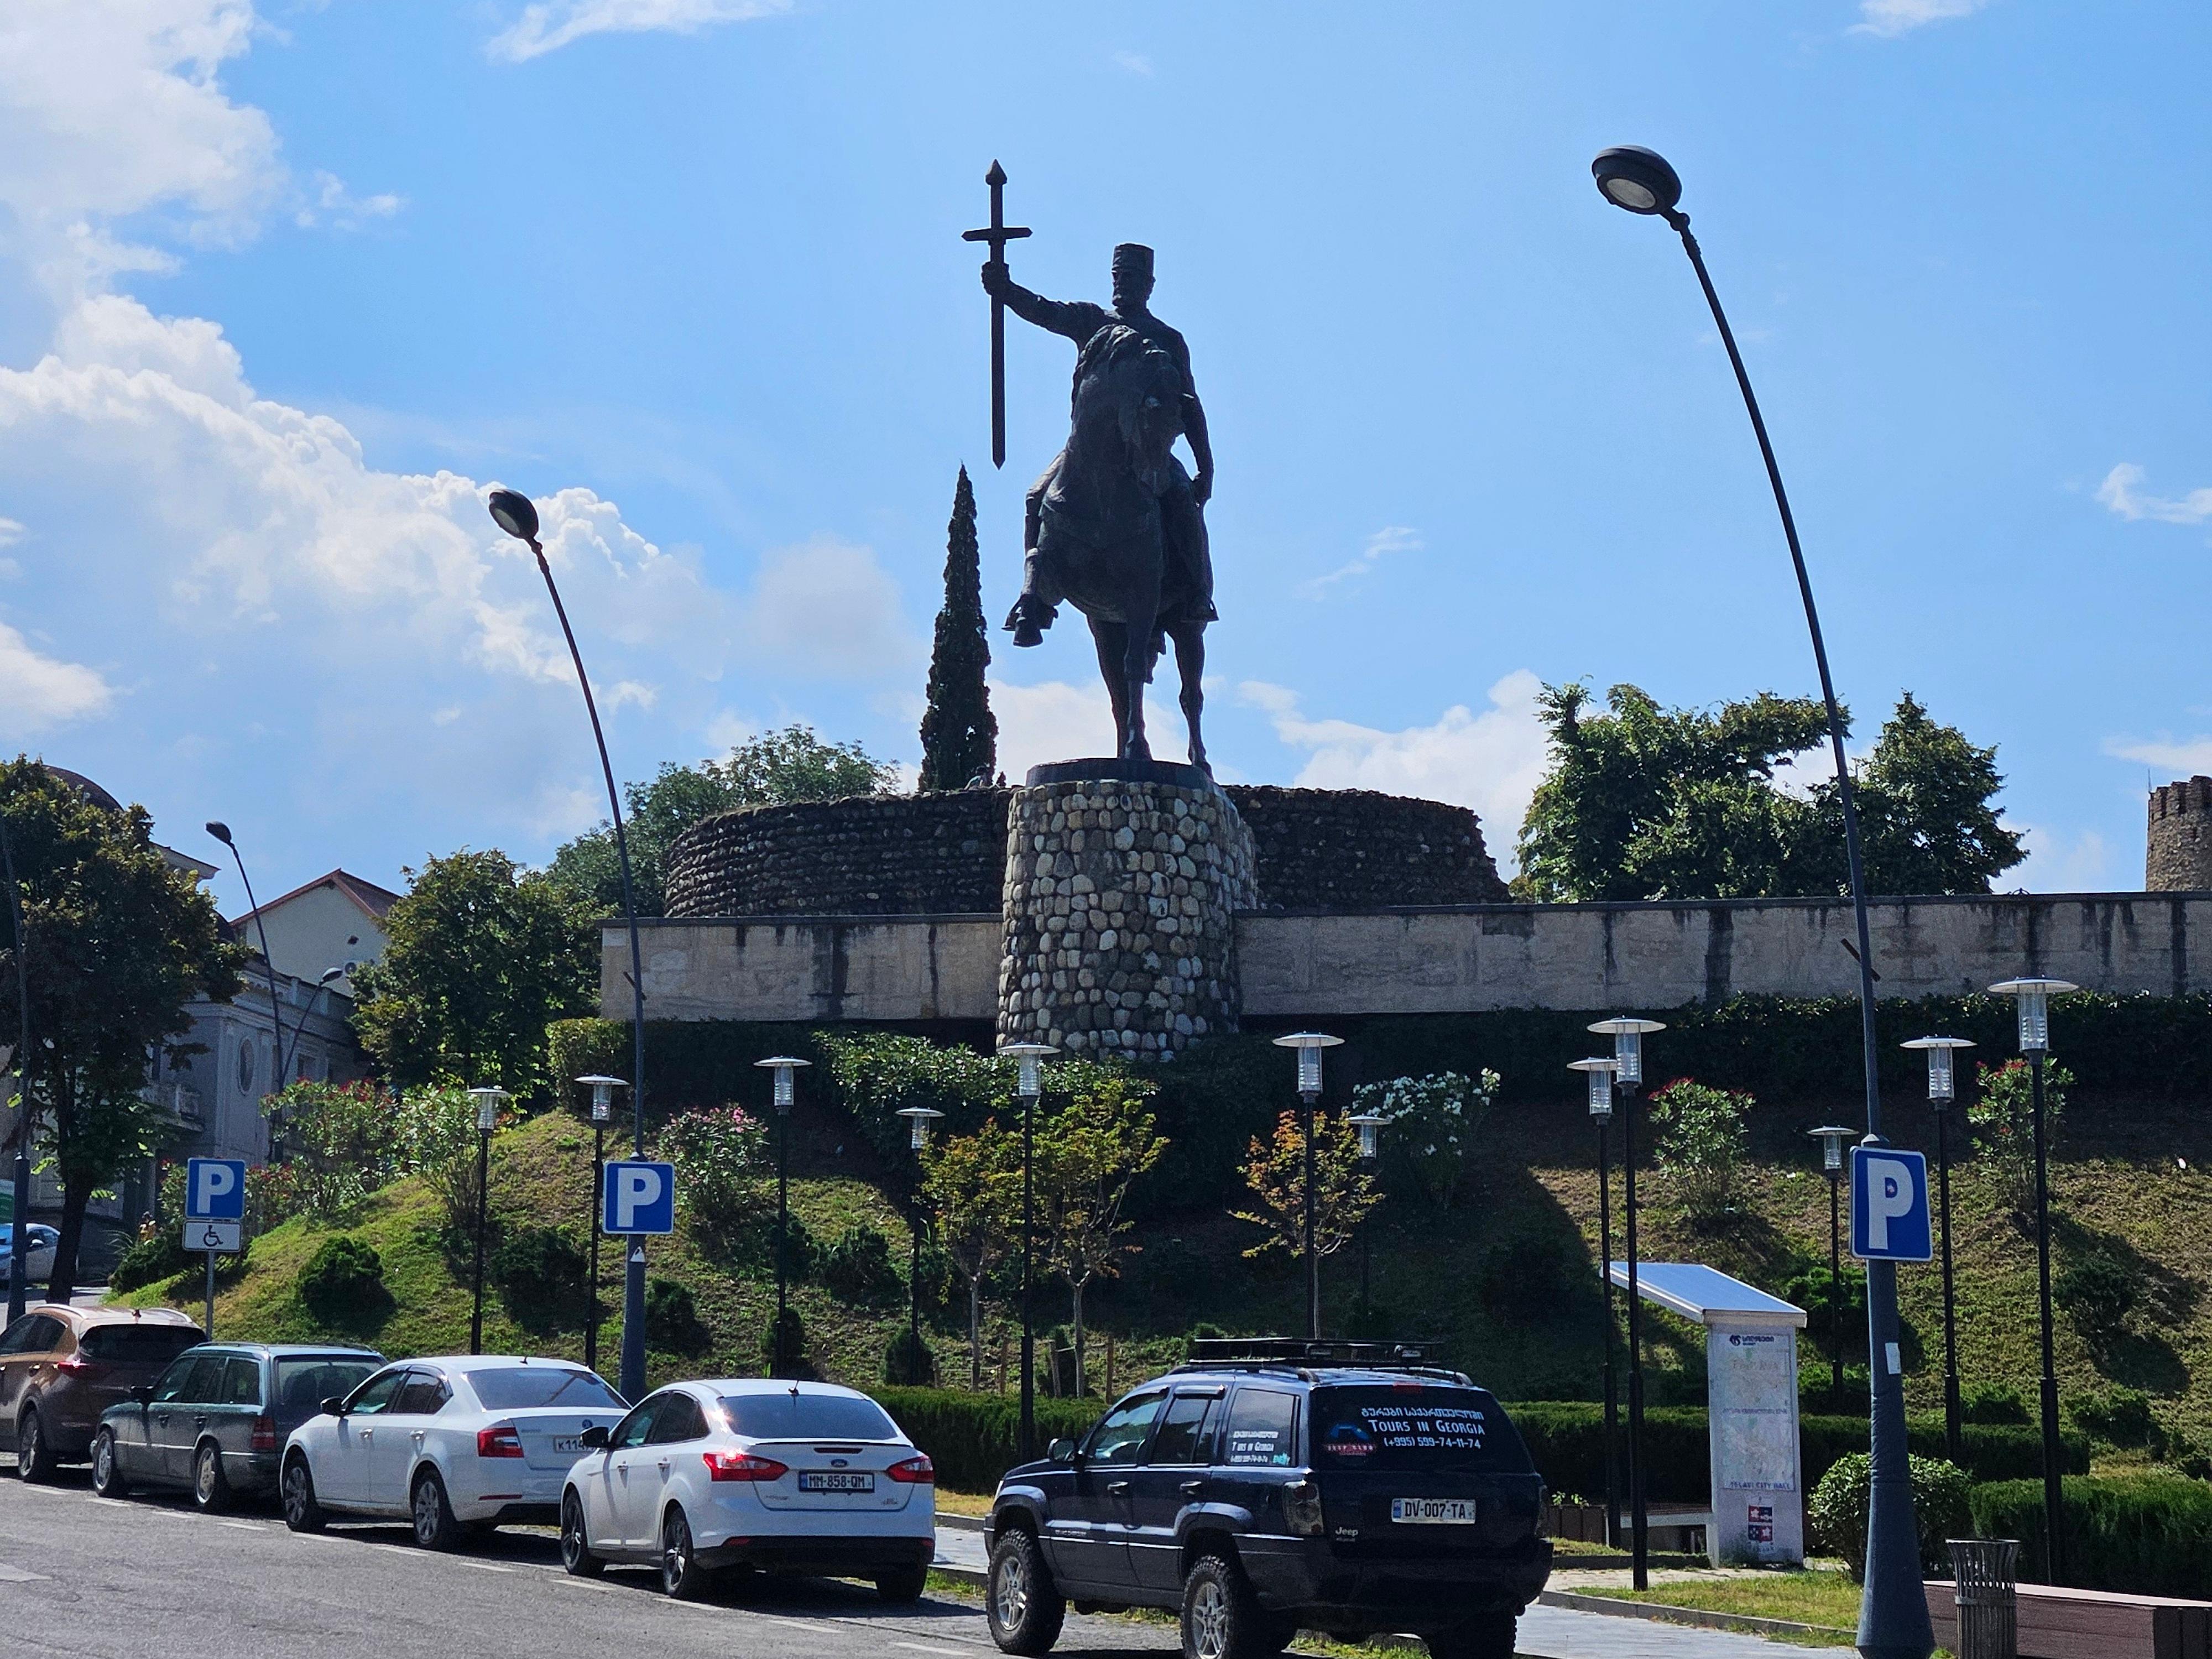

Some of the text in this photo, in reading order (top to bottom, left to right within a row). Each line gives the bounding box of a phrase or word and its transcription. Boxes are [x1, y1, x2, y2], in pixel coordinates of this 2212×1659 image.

[197, 1164, 234, 1213] P
[617, 1167, 662, 1227] P
[1867, 1158, 1914, 1250] P
[1436, 1420, 1485, 1435] GEORGIA
[1417, 1437, 1481, 1449] 599-74-11-74
[808, 1475, 865, 1488] MM-858-QM
[1404, 1500, 1465, 1519] DV-007-TA
[1335, 1526, 1359, 1537] Jeep
